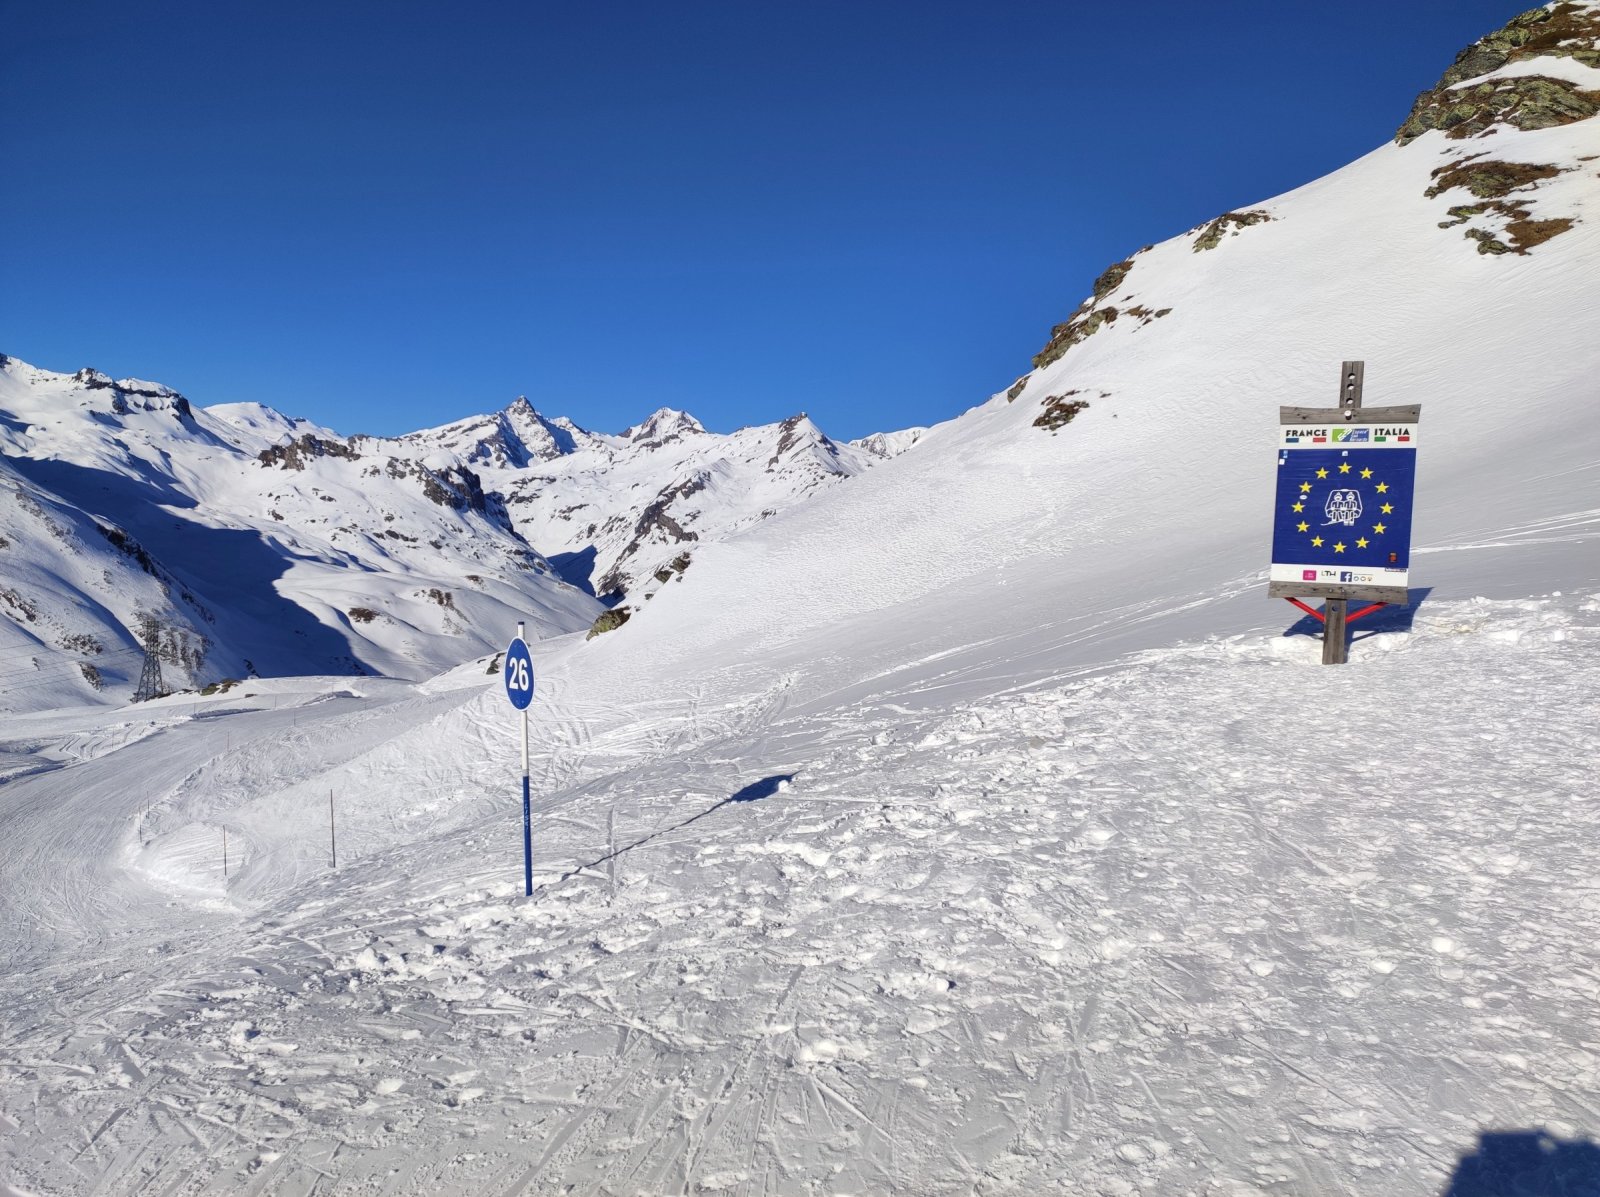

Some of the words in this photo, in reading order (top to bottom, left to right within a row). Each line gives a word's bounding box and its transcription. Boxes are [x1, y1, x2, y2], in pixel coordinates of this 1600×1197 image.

[1285, 429, 1327, 437] FRANCE
[1374, 428, 1410, 436] ITALIA
[509, 657, 529, 691] 26
